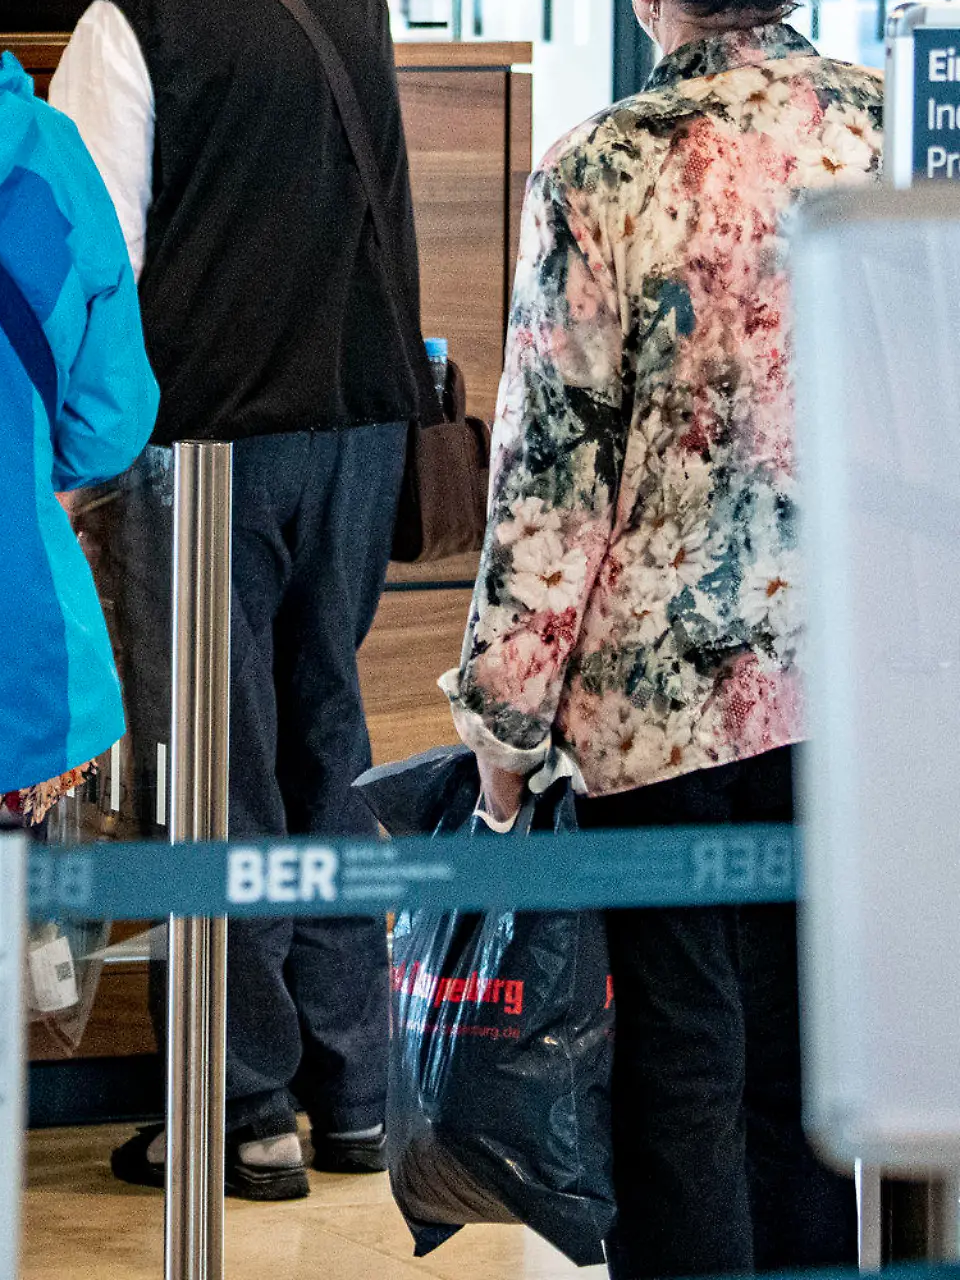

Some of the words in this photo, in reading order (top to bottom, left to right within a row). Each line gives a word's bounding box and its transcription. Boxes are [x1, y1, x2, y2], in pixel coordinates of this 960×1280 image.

[928, 47, 960, 82] Ei
[927, 97, 960, 131] In
[926, 145, 960, 179] Pr
[225, 846, 338, 904] BER
